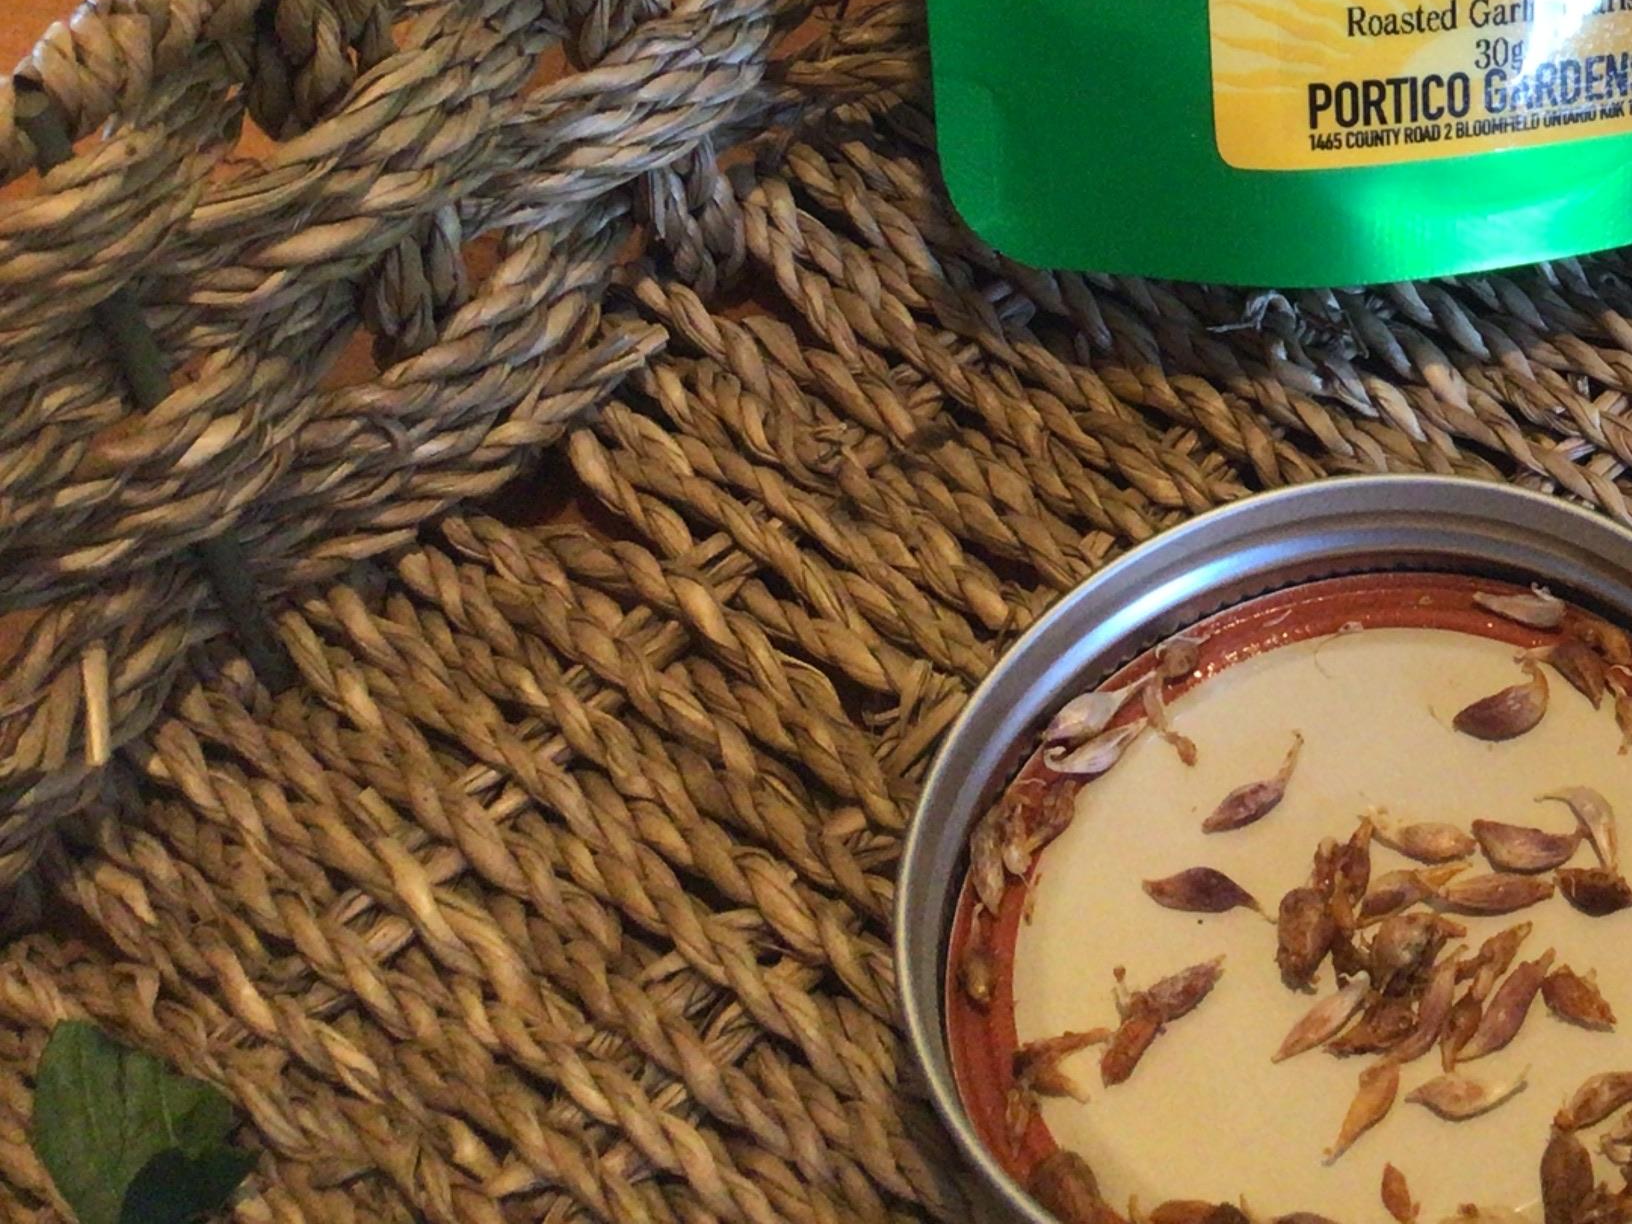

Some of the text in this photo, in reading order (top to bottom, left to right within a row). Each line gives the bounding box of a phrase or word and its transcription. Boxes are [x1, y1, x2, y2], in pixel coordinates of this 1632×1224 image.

[1308, 72, 1471, 130] PORTICO
[1308, 132, 1343, 151] 1465
[1345, 127, 1401, 149] COUNTY
[1404, 123, 1441, 144] ROAD
[1444, 122, 1453, 140] 2
